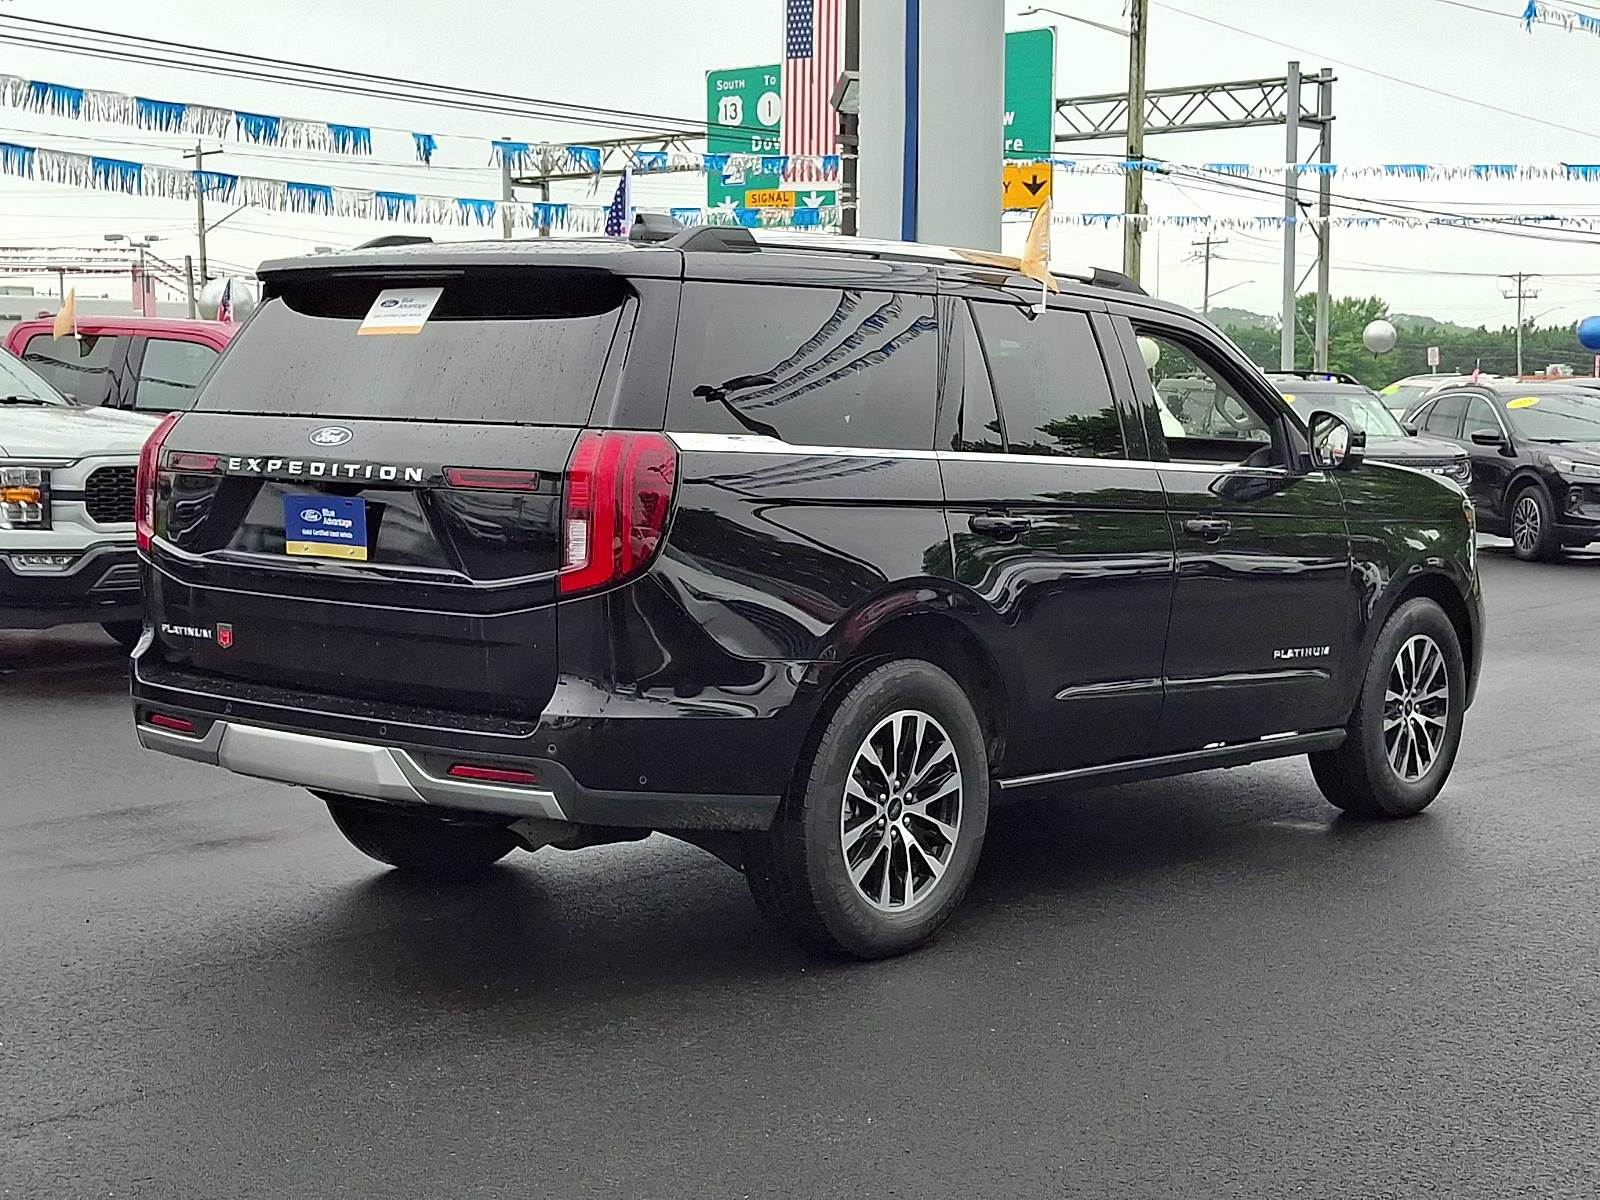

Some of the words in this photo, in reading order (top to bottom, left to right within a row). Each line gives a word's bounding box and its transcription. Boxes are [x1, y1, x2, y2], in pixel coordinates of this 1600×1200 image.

[716, 79, 746, 91] SOUTH
[723, 102, 738, 121] 13
[767, 100, 772, 118] 1
[751, 191, 790, 204] SIGNAL
[314, 427, 347, 444] Ford
[228, 457, 424, 482] EXPEDITION
[161, 623, 213, 639] PLATINUM
[1273, 646, 1330, 659] PLATINUM
